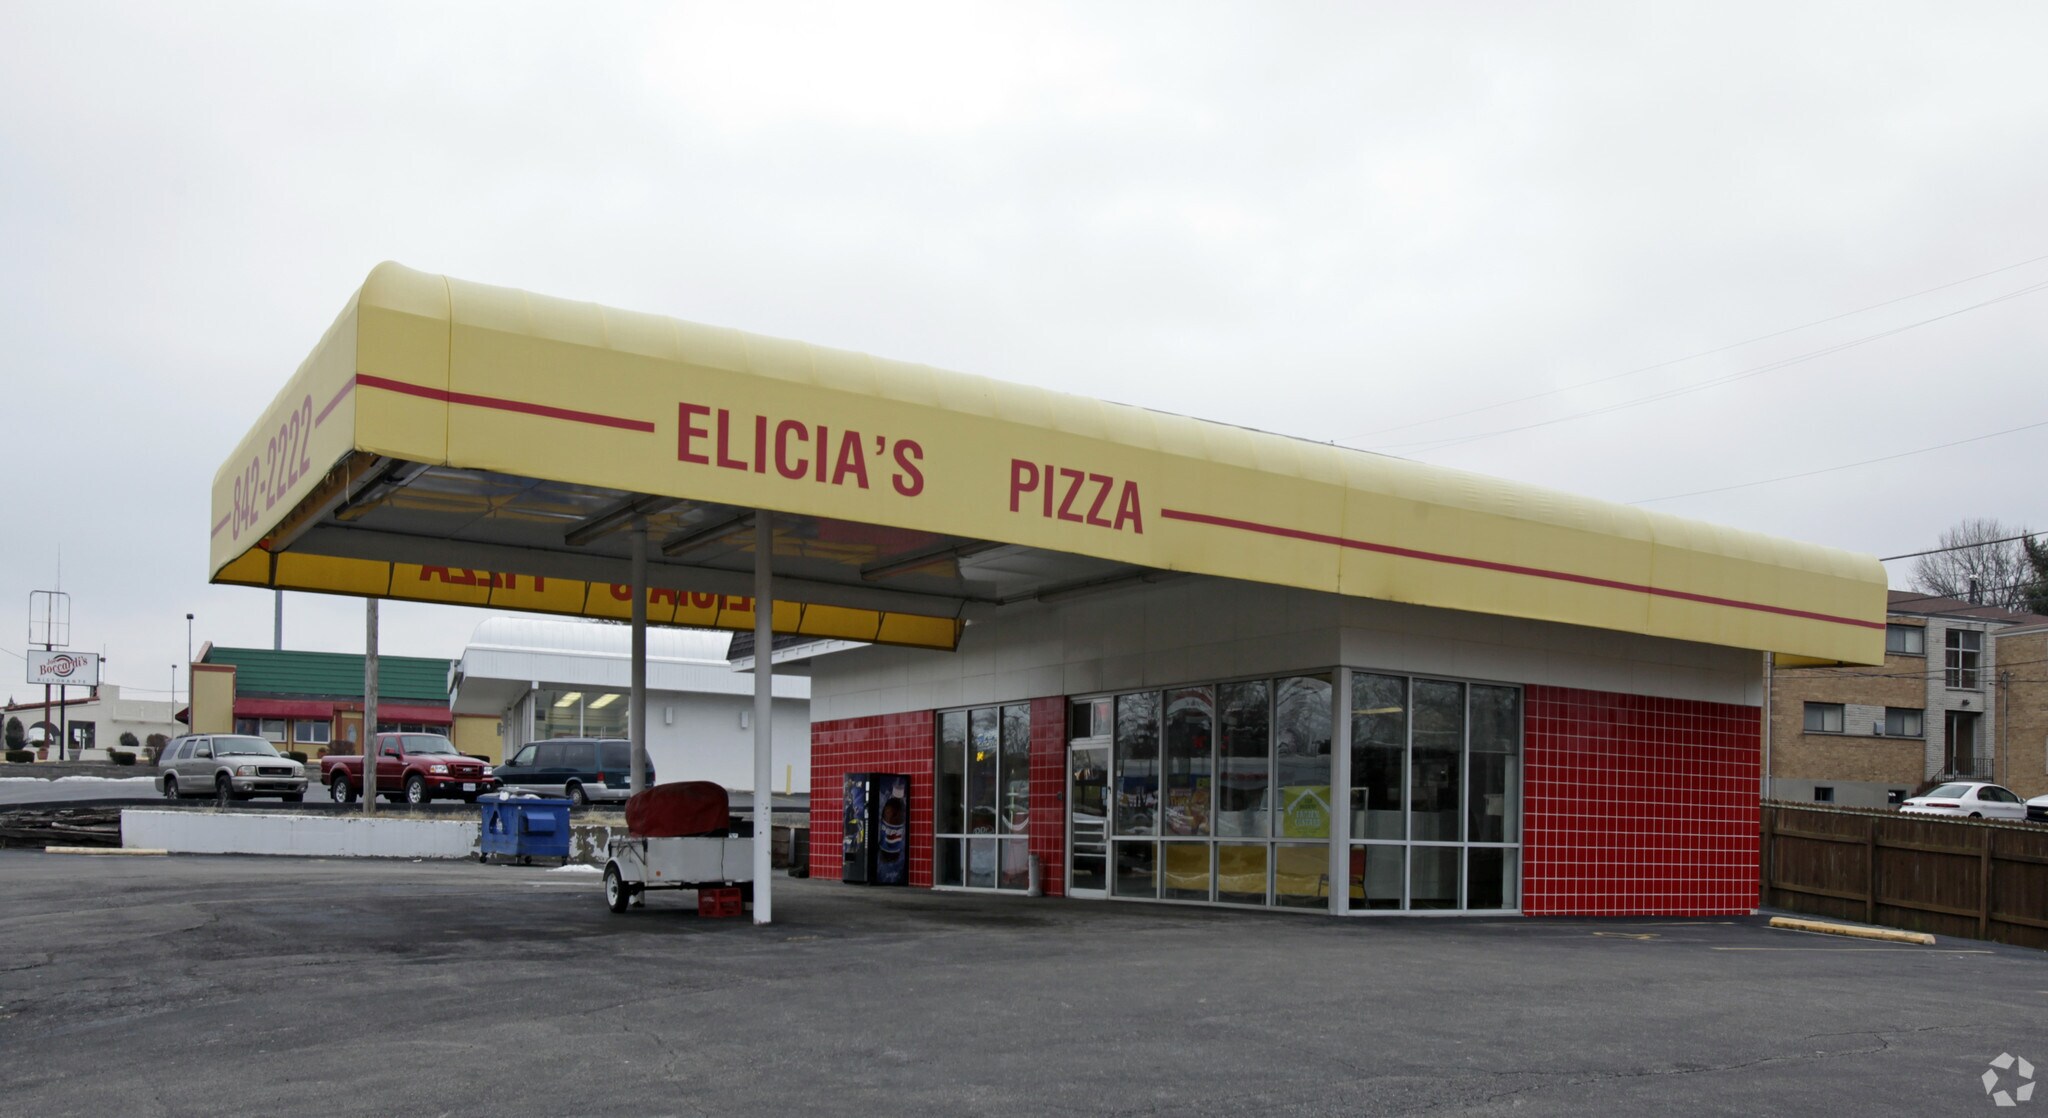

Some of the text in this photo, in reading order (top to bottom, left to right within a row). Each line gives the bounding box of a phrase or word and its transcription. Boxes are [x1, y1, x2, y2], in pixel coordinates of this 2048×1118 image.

[232, 394, 312, 541] 842-2222
[677, 402, 1144, 535] ELICIA'S PIZZA
[40, 656, 88, 675] Boccardi's
